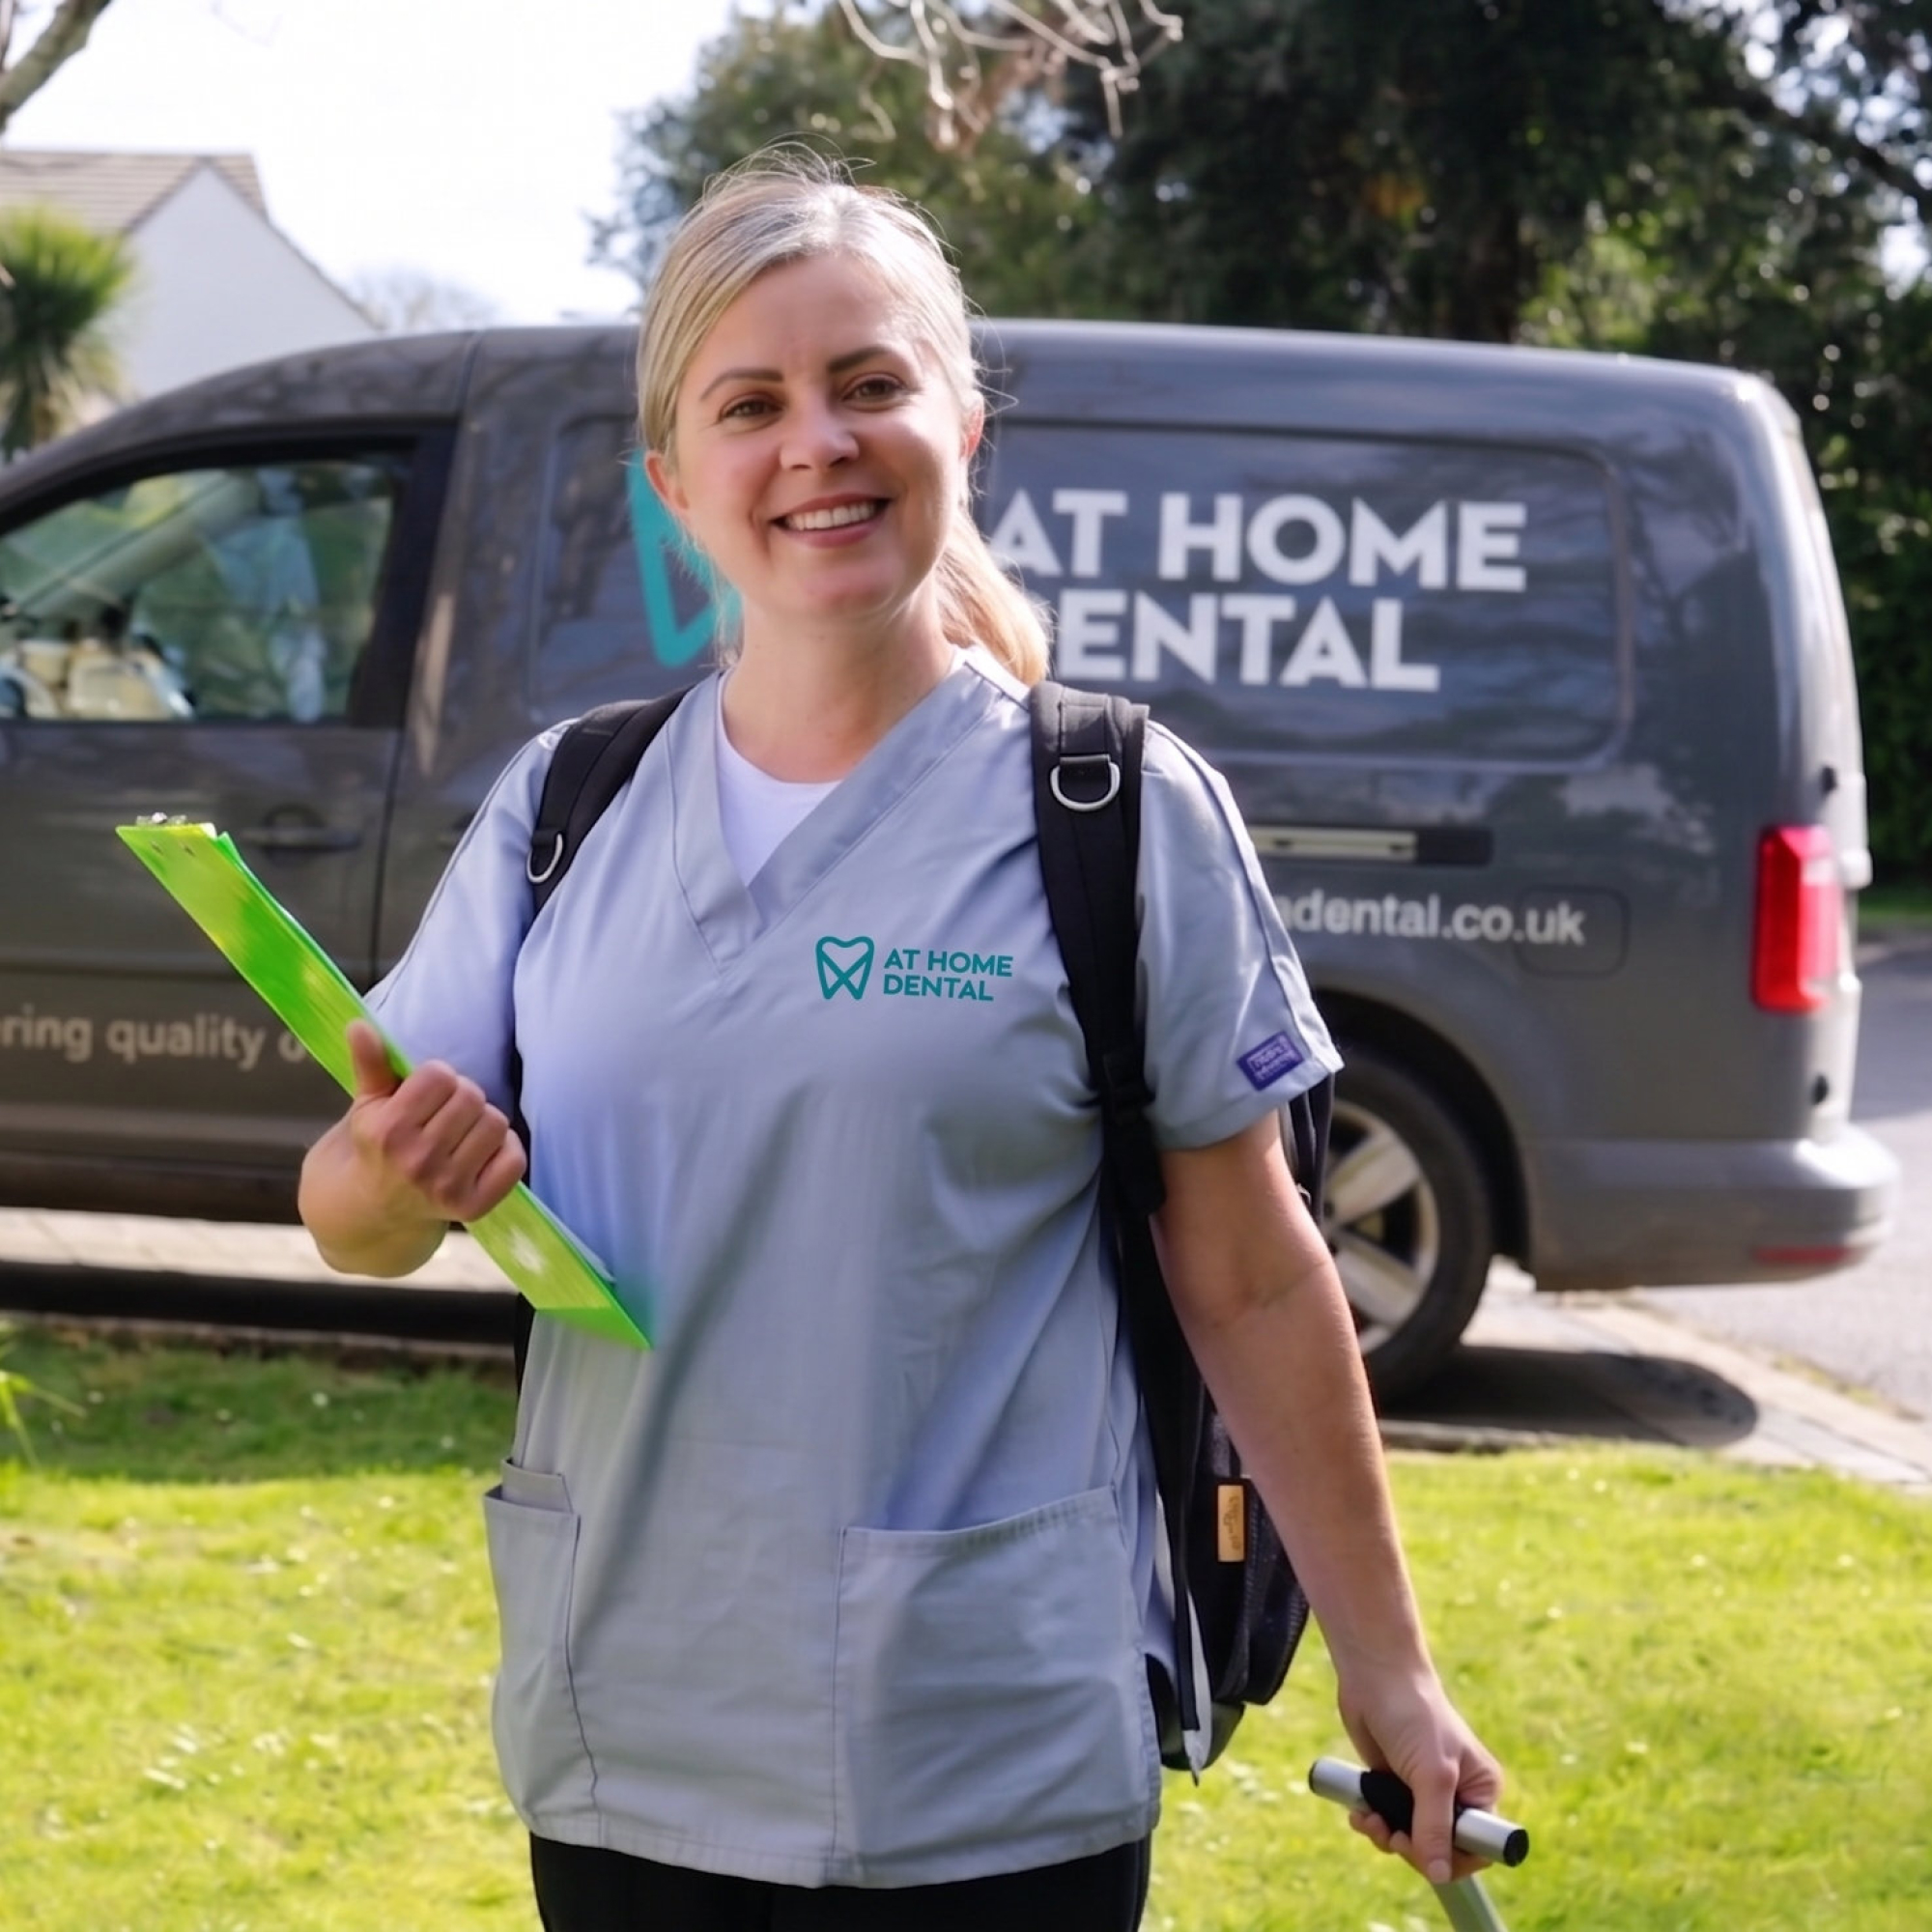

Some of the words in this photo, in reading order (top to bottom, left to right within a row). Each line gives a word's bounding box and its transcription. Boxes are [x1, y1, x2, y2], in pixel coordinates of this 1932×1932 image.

[989, 487, 1128, 577] AT
[1160, 493, 1527, 592] HOME
[1057, 588, 1439, 692] ENTAL
[883, 974, 994, 1002] DENTAL
[884, 948, 921, 970] AT
[927, 950, 1013, 977] HOME
[0, 1003, 94, 1064] ring
[105, 1012, 266, 1071] quality
